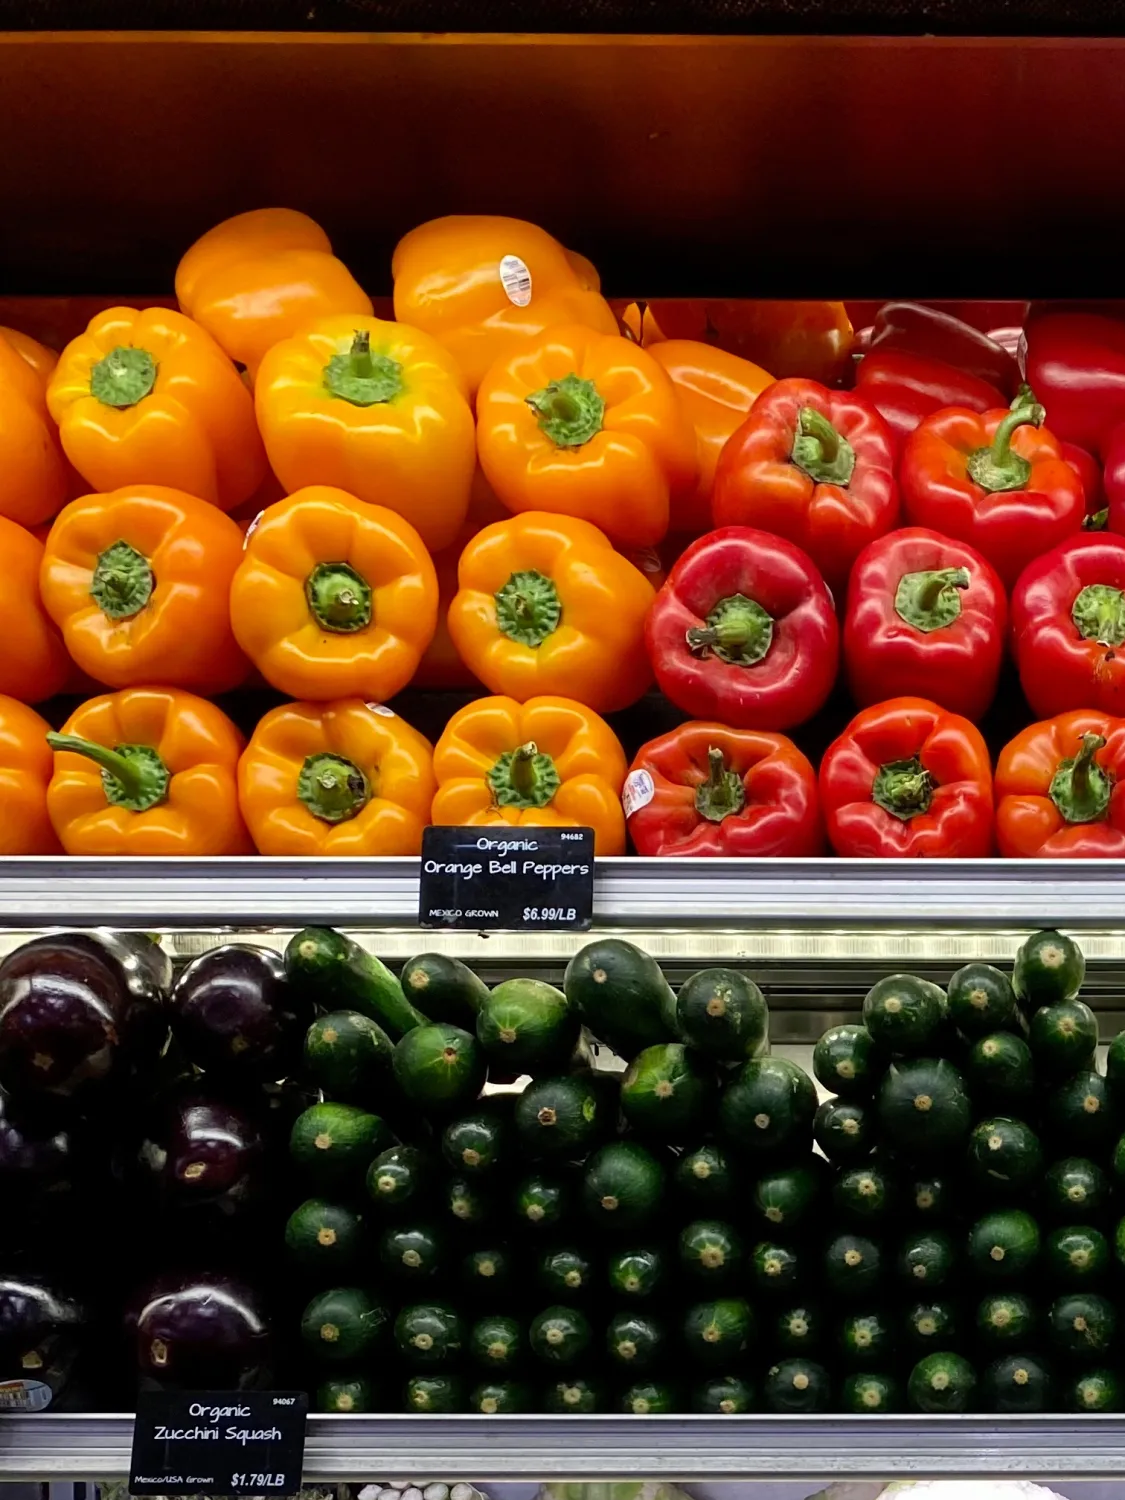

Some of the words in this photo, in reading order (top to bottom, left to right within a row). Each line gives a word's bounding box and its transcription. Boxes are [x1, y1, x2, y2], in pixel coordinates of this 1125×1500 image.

[477, 838, 538, 857] Organic
[424, 860, 482, 880] Orange
[489, 860, 517, 874] Bell
[523, 861, 589, 880] Peppers
[523, 907, 577, 921] $6.99/LB
[189, 1403, 251, 1423] Organic
[154, 1426, 219, 1440] Zucchini
[225, 1426, 282, 1446] Squash
[231, 1473, 285, 1487] $1.79/LB
